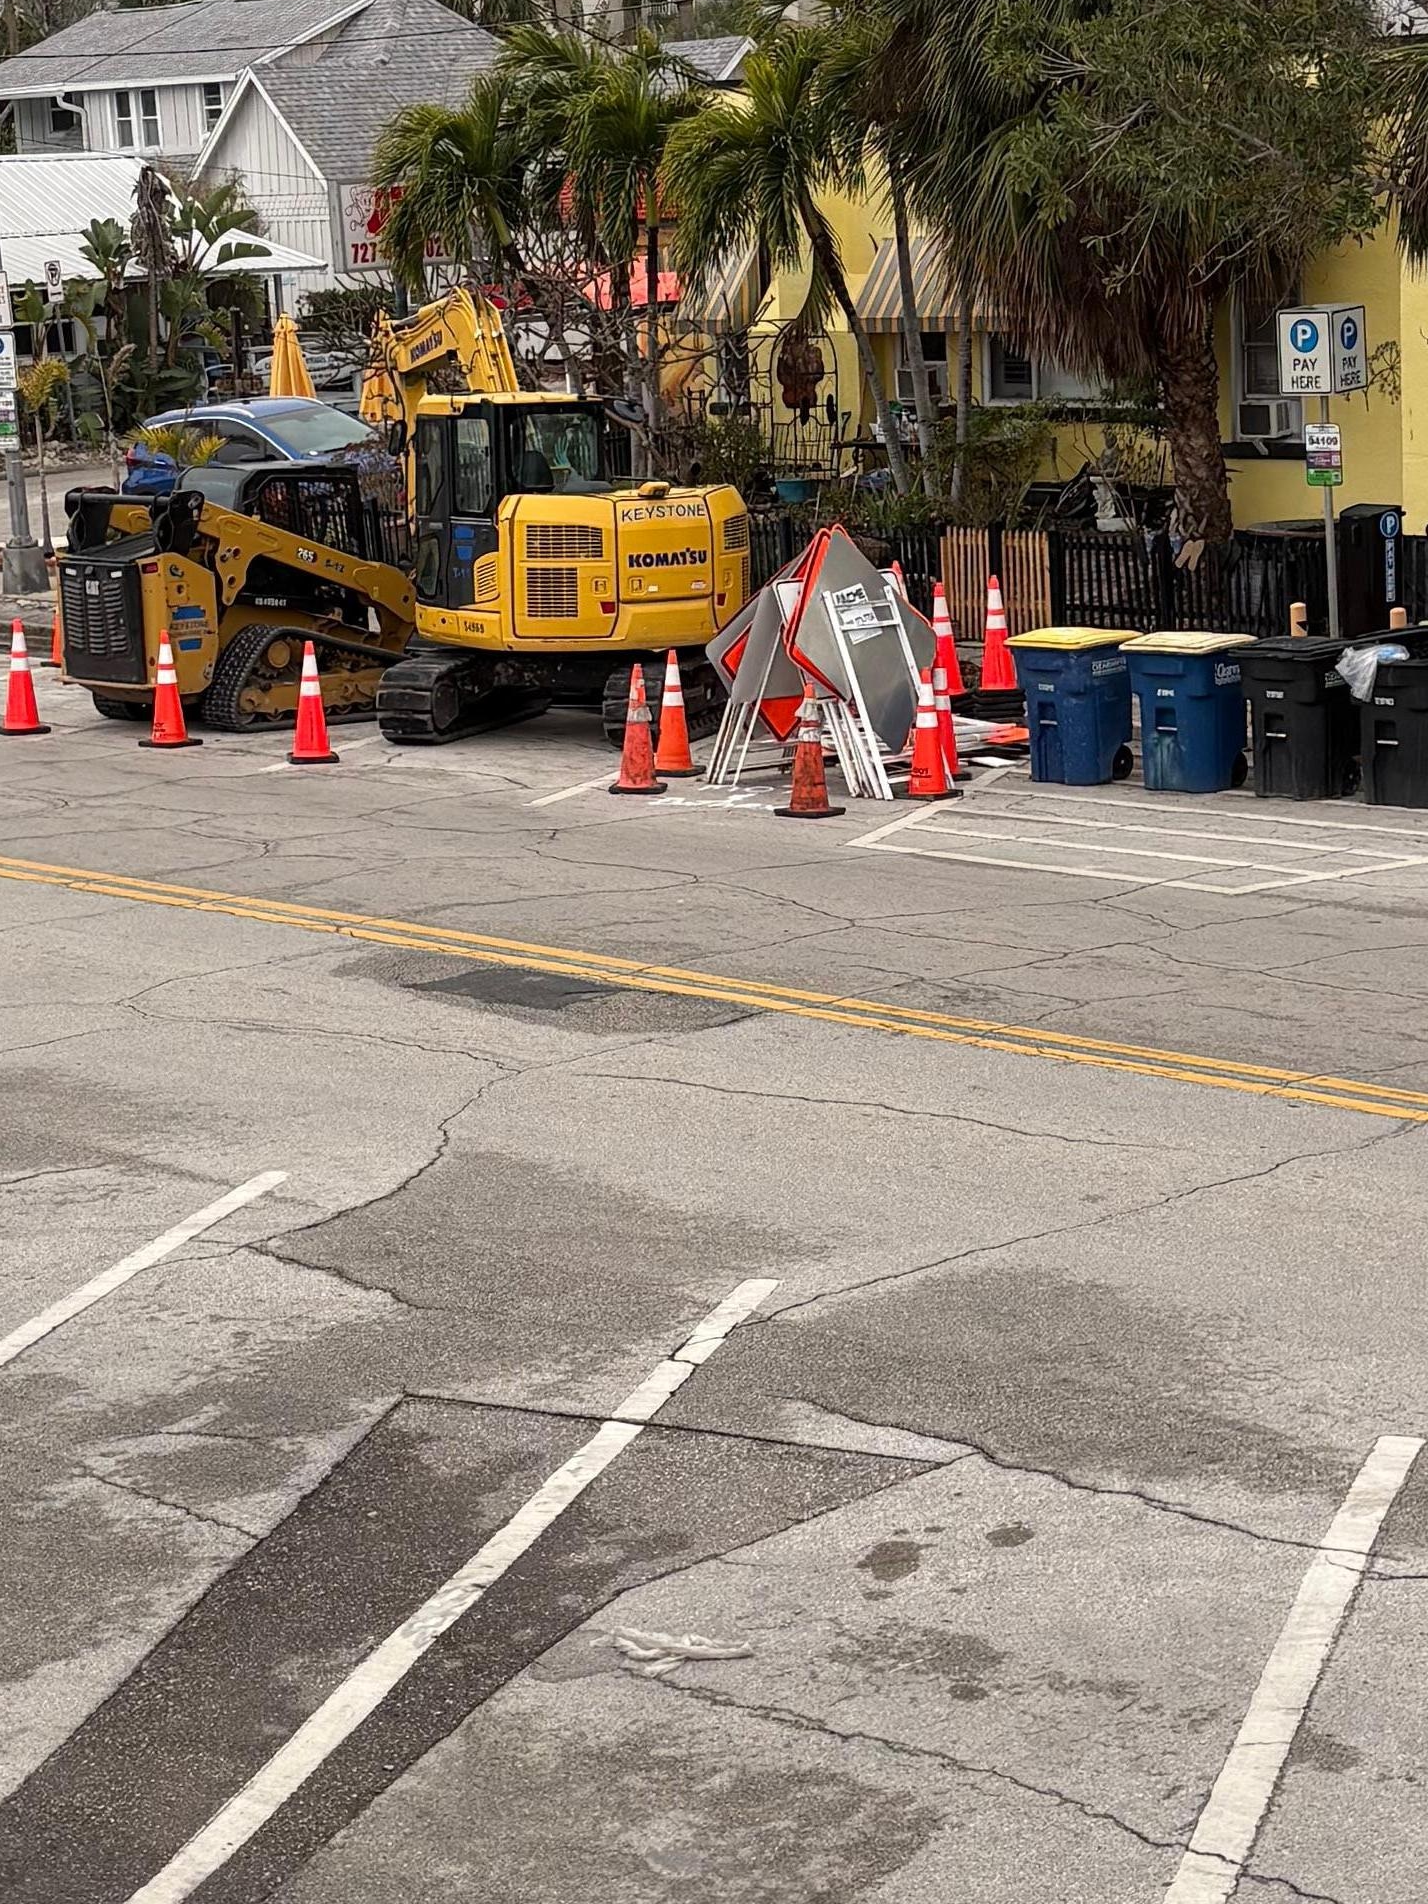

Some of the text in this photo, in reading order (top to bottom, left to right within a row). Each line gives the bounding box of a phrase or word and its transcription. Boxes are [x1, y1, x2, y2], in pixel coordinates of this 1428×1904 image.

[411, 330, 442, 364] KOMATSU
[1293, 358, 1318, 372] PAY
[1342, 356, 1358, 371] PAY
[1291, 375, 1321, 389] HERE
[1340, 370, 1361, 387] HERE
[621, 504, 706, 523] KEYSTONE
[298, 547, 315, 563] 265
[628, 547, 708, 569] KOMATSU
